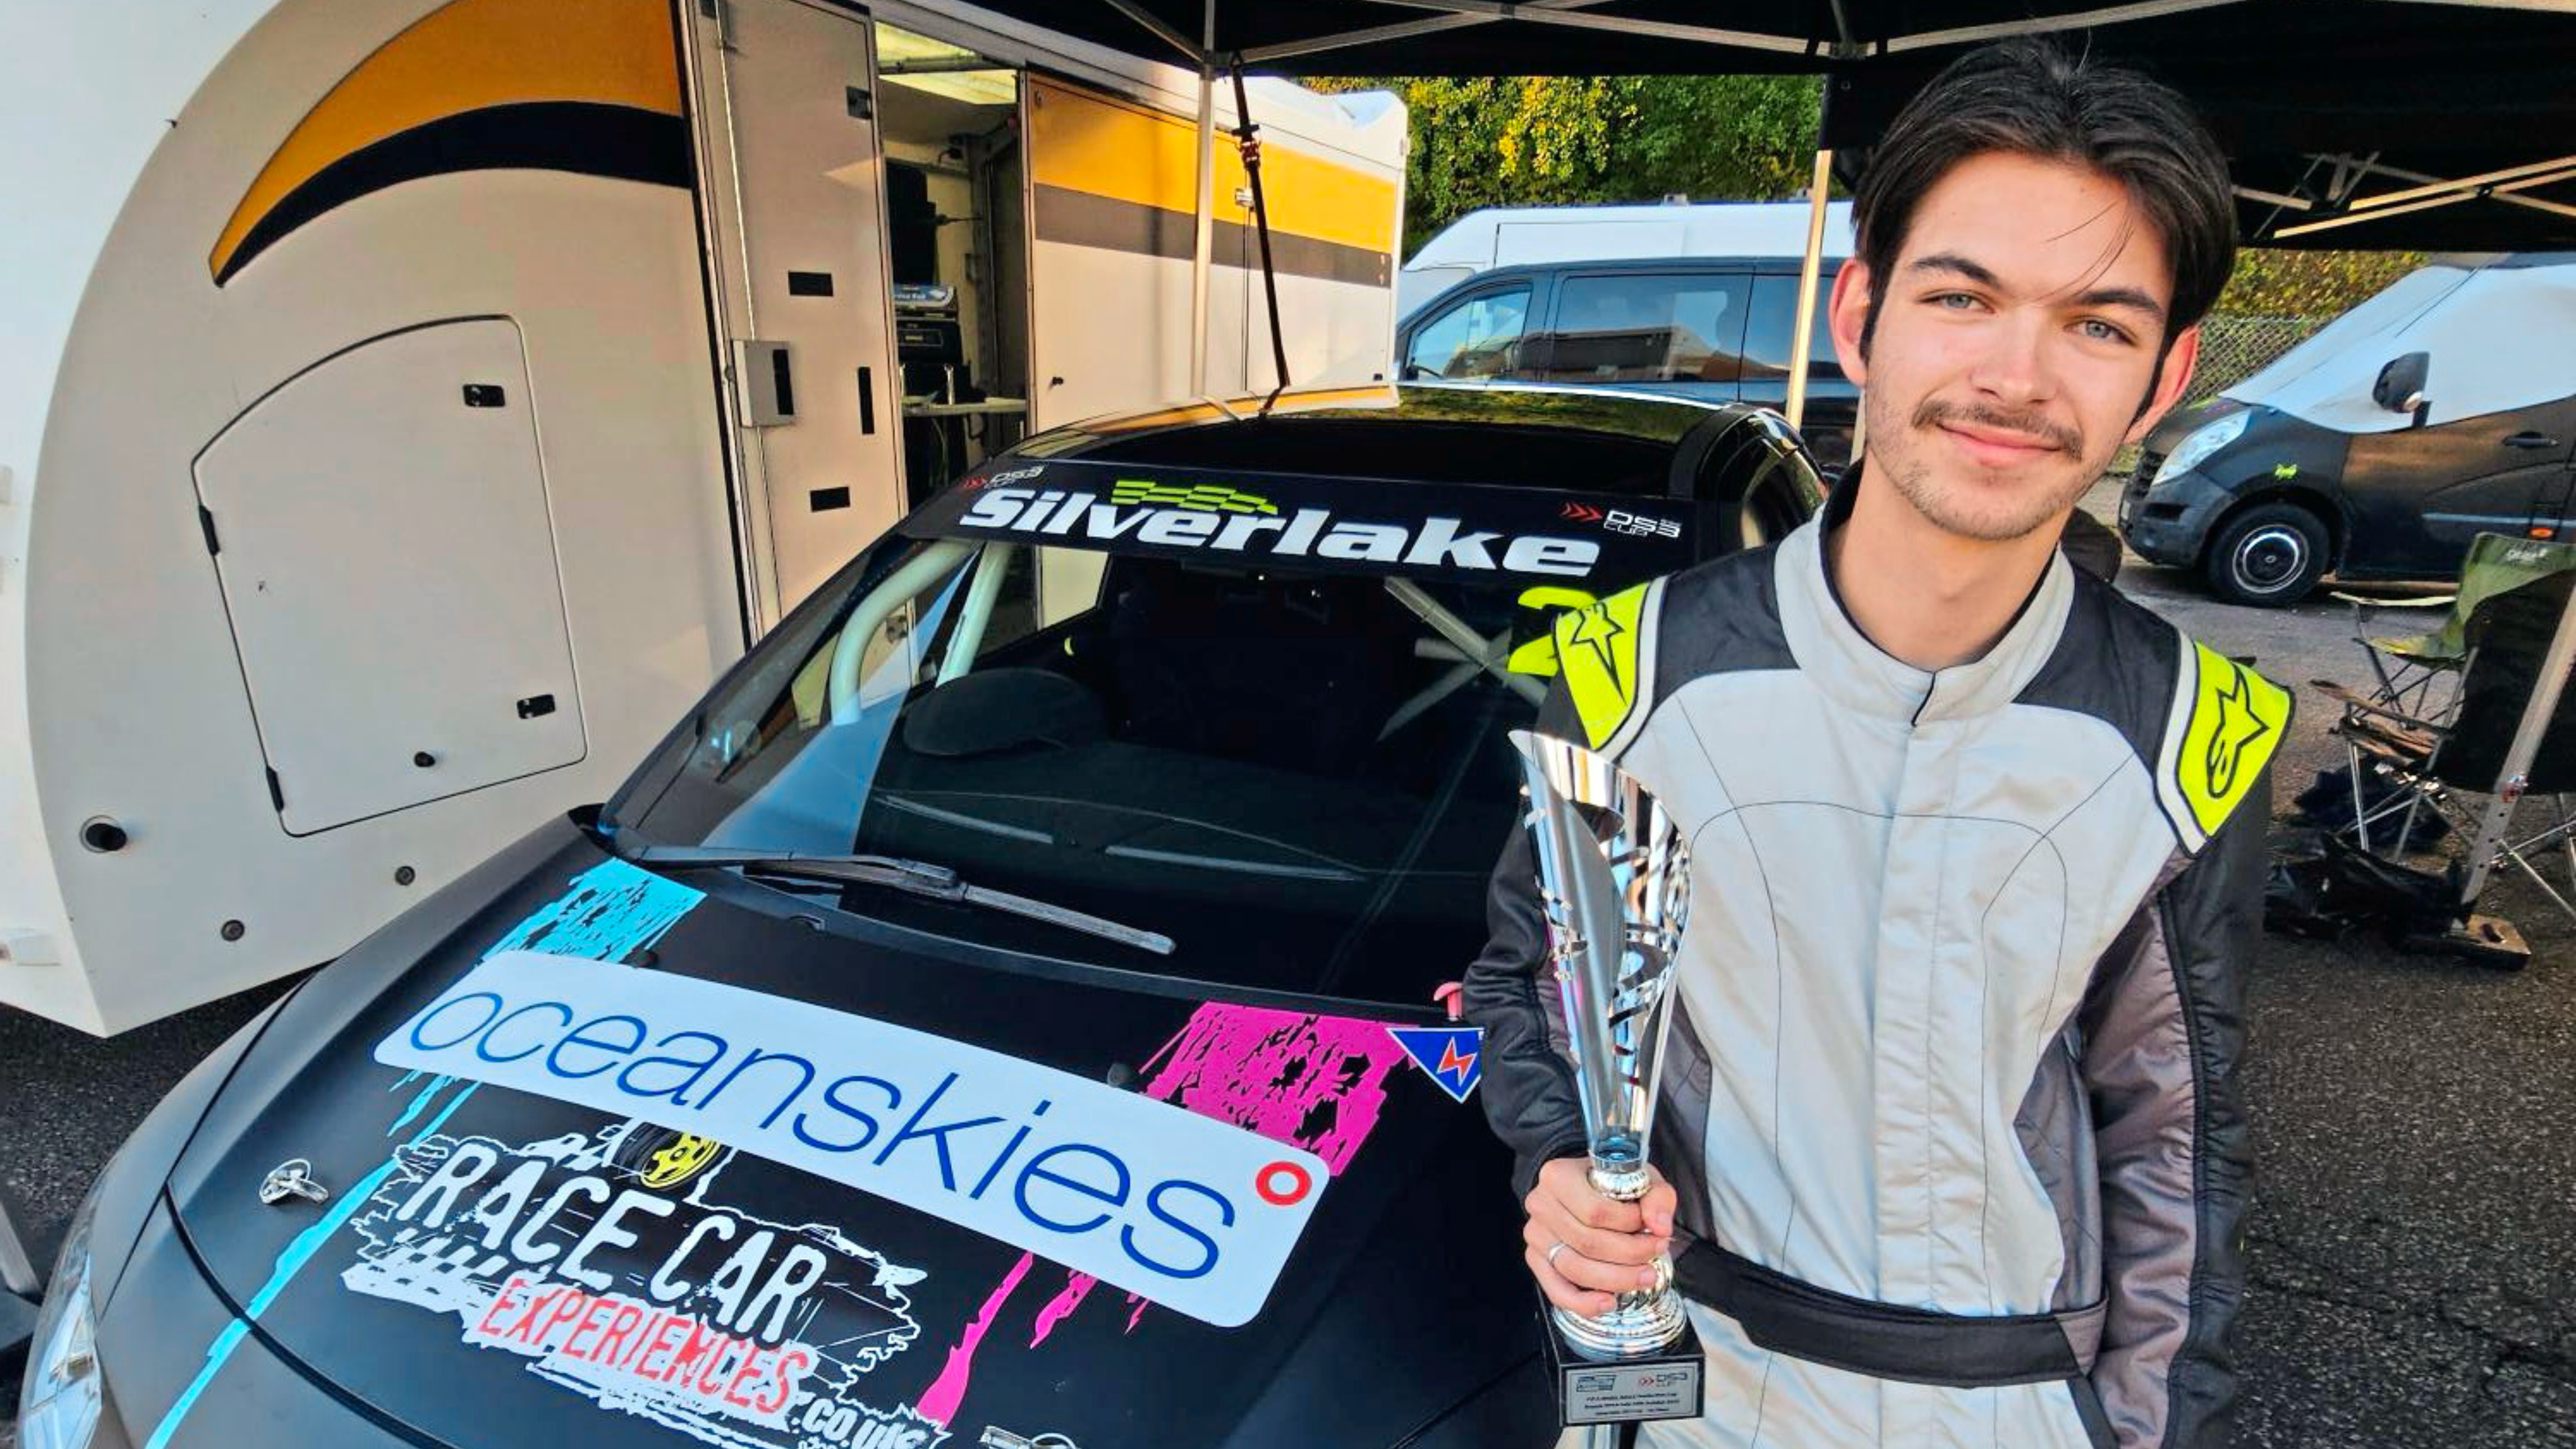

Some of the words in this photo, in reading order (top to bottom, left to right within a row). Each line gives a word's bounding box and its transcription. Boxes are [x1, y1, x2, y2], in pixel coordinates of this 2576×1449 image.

[960, 489, 1599, 576] Silverlake
[1606, 510, 1681, 537] DS3
[410, 993, 1235, 1279] oceanskies
[396, 1143, 675, 1290] RACE
[650, 1215, 827, 1343] CAR
[479, 1278, 808, 1414] EXPERIENCES
